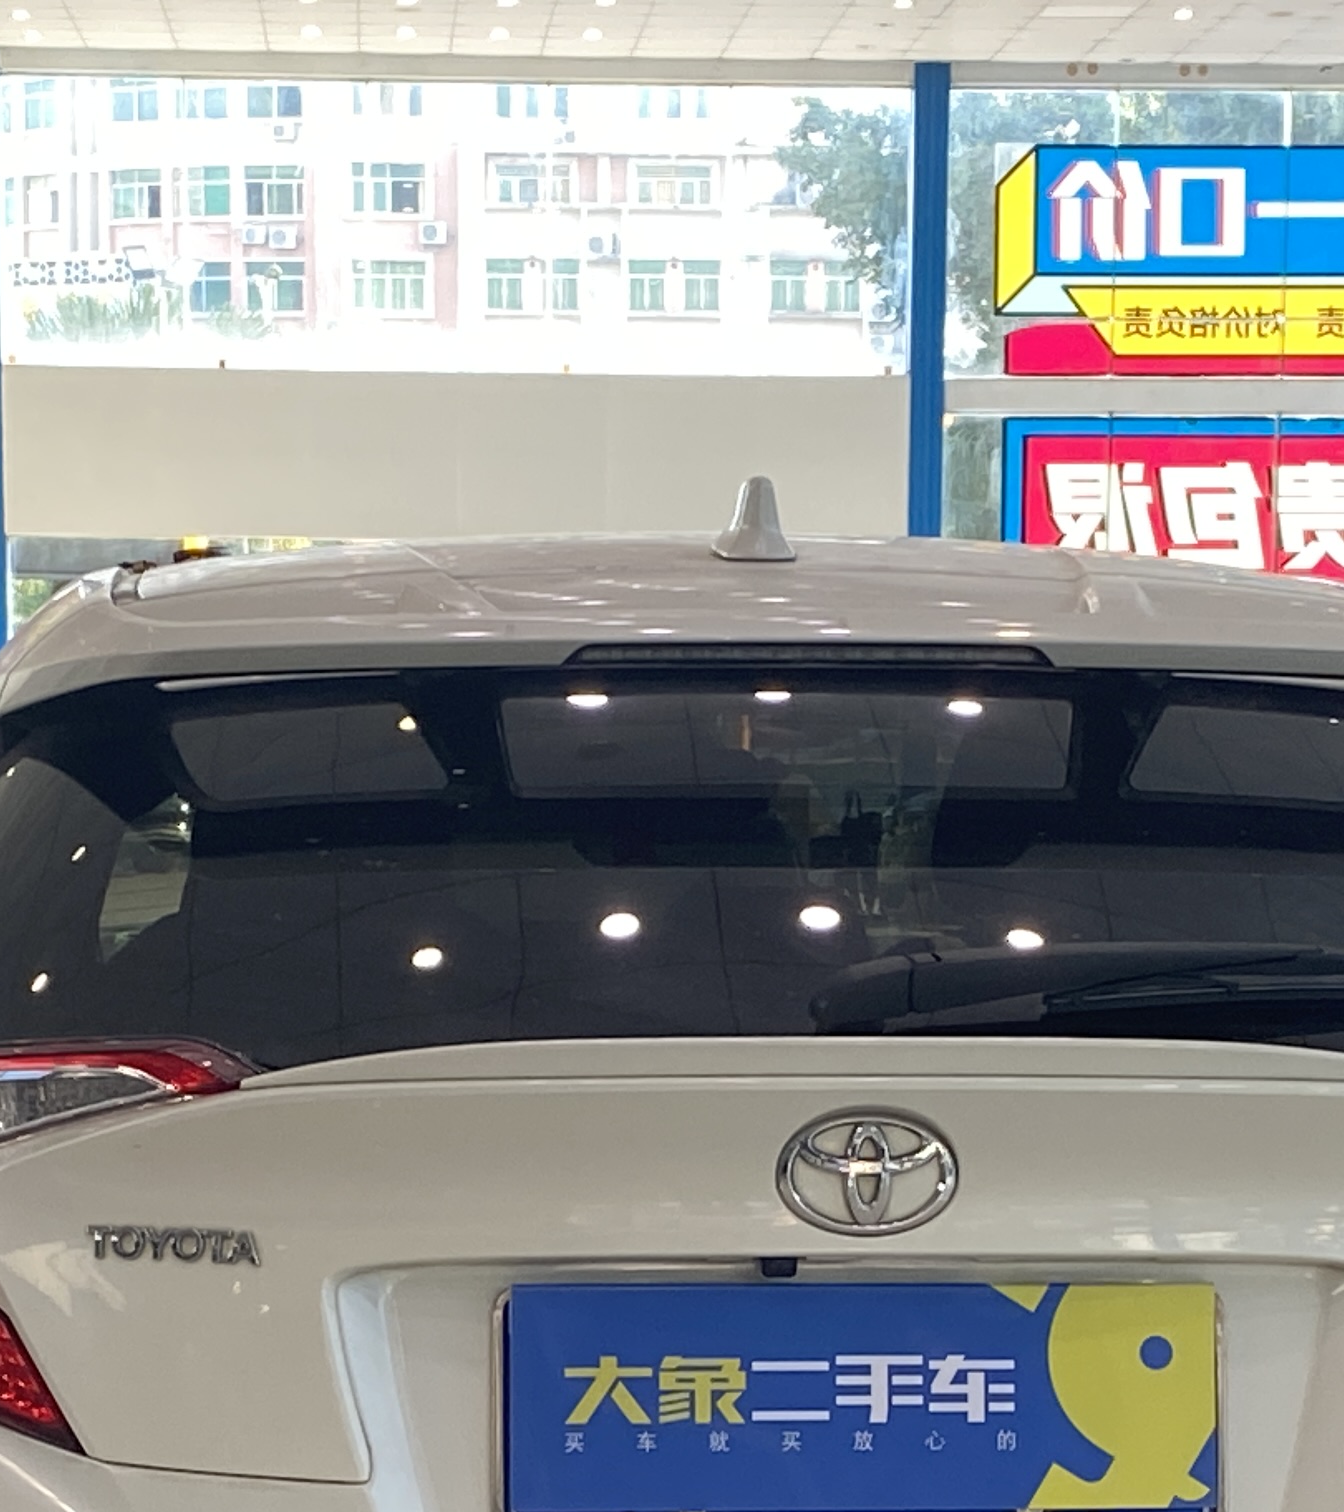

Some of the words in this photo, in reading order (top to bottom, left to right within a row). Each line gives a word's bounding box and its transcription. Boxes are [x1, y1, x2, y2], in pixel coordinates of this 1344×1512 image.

[86, 1224, 261, 1267] TOYOTA
[562, 1352, 1018, 1425] 大象二手车
[562, 1428, 1018, 1455] 买车就买放心的
